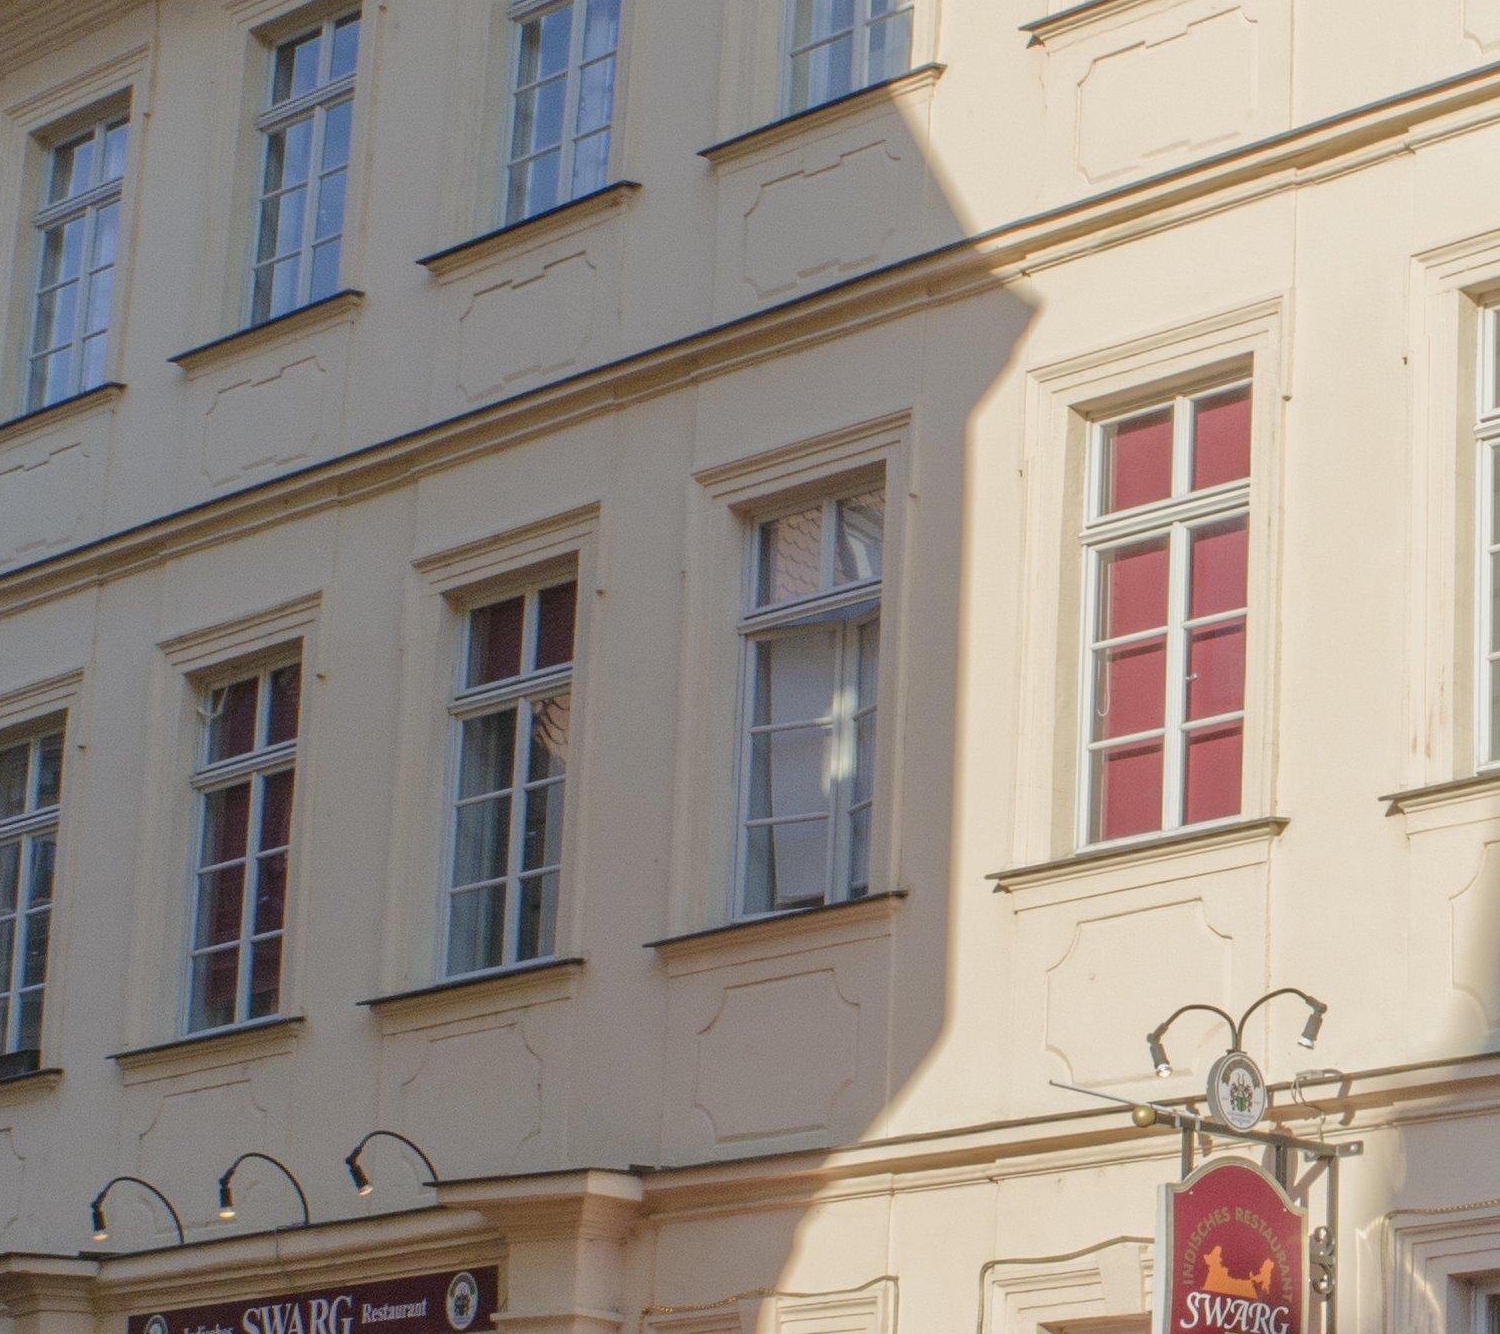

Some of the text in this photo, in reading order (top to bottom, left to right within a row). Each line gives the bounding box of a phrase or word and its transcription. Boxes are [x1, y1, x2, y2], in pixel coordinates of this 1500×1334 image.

[1182, 1206, 1293, 1303] INDISCHES RESTAURANT
[361, 1298, 429, 1325] Restaurant
